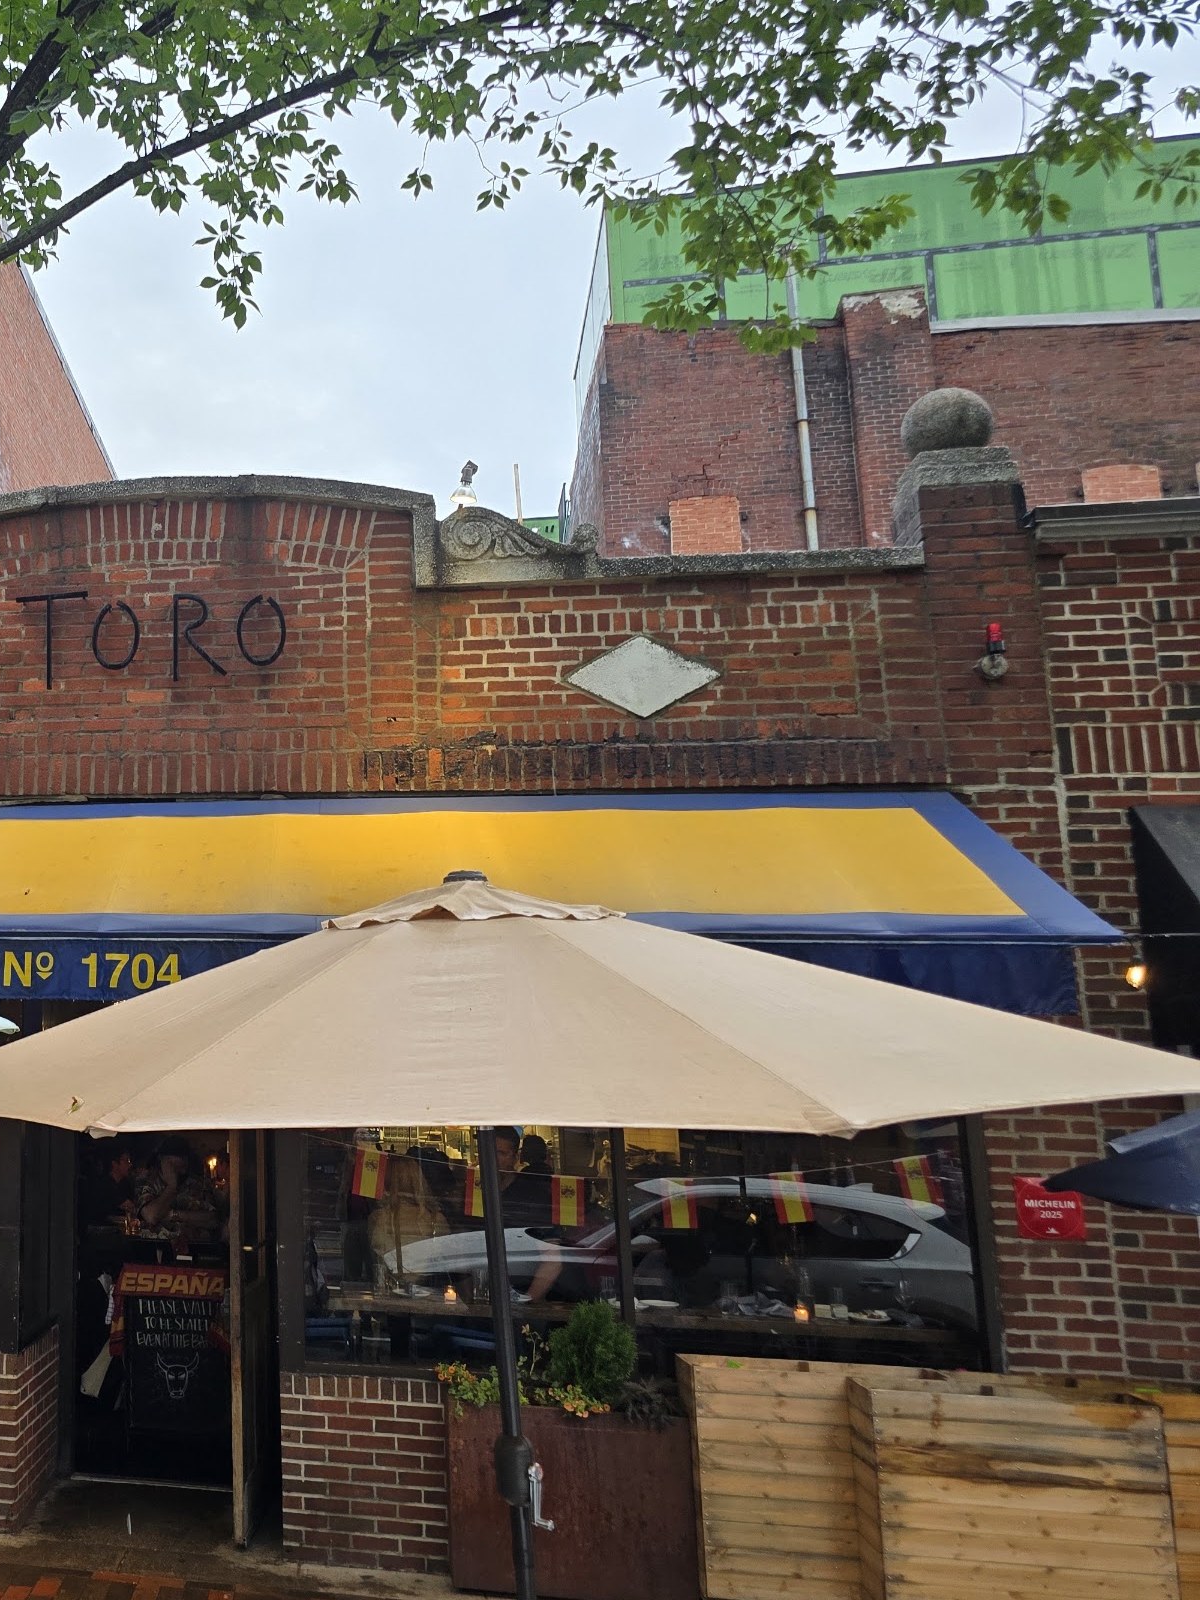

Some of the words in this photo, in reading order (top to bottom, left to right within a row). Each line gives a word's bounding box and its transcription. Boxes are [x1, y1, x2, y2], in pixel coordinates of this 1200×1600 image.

[15, 590, 287, 690] TORO
[81, 952, 182, 990] 1704
[1024, 1199, 1076, 1209] MICHELIN
[1040, 1210, 1063, 1219] 2025
[120, 1271, 225, 1297] ESPAÑA
[144, 1316, 157, 1329] TO
